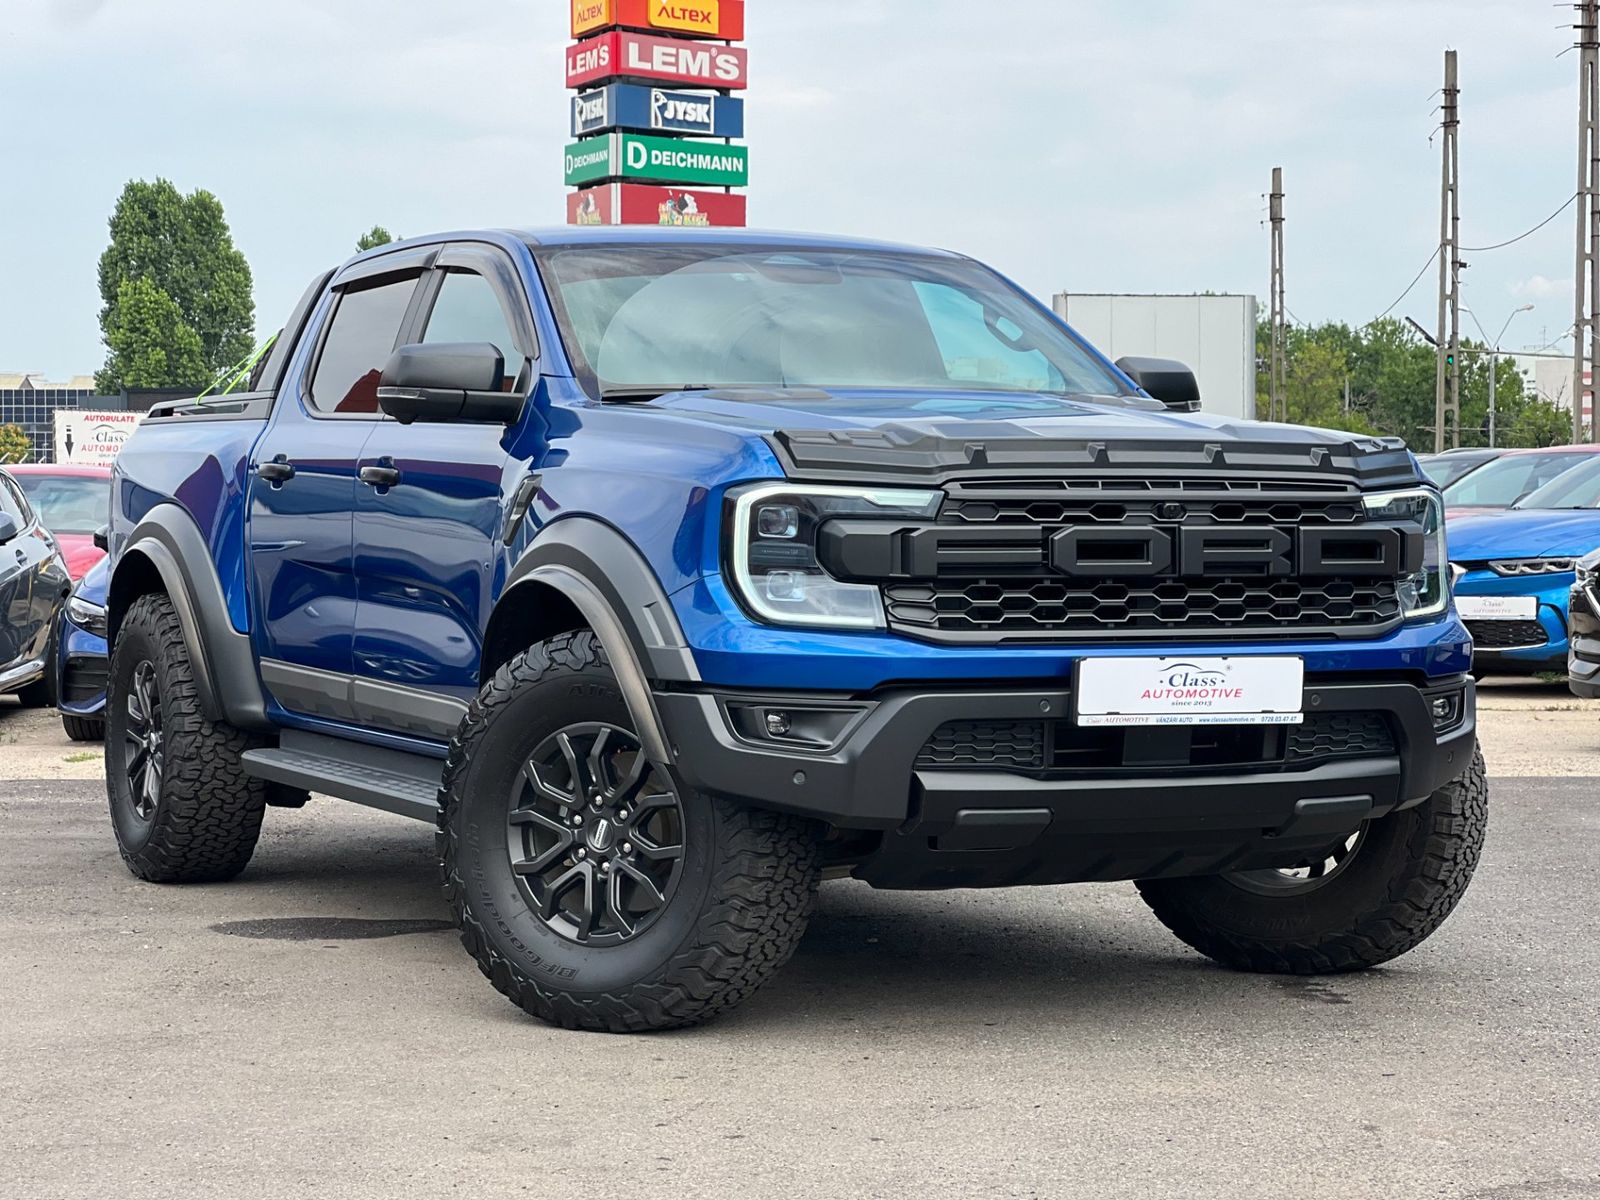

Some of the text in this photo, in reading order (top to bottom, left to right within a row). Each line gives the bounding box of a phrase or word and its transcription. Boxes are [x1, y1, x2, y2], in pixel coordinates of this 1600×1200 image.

[567, 44, 609, 77] LEM'S
[628, 42, 740, 80] LEM'S
[581, 98, 603, 121] JYSK
[664, 100, 710, 123] JYSK
[574, 149, 608, 168] DEICHMANN
[651, 150, 744, 172] DEICHMANN
[84, 415, 135, 423] AUTORULATE
[96, 432, 124, 443] Class
[81, 444, 123, 452] AUTOMO
[904, 522, 1401, 578] FORD
[1168, 672, 1217, 687] Class
[1141, 688, 1244, 699] AUTOMOTIVE
